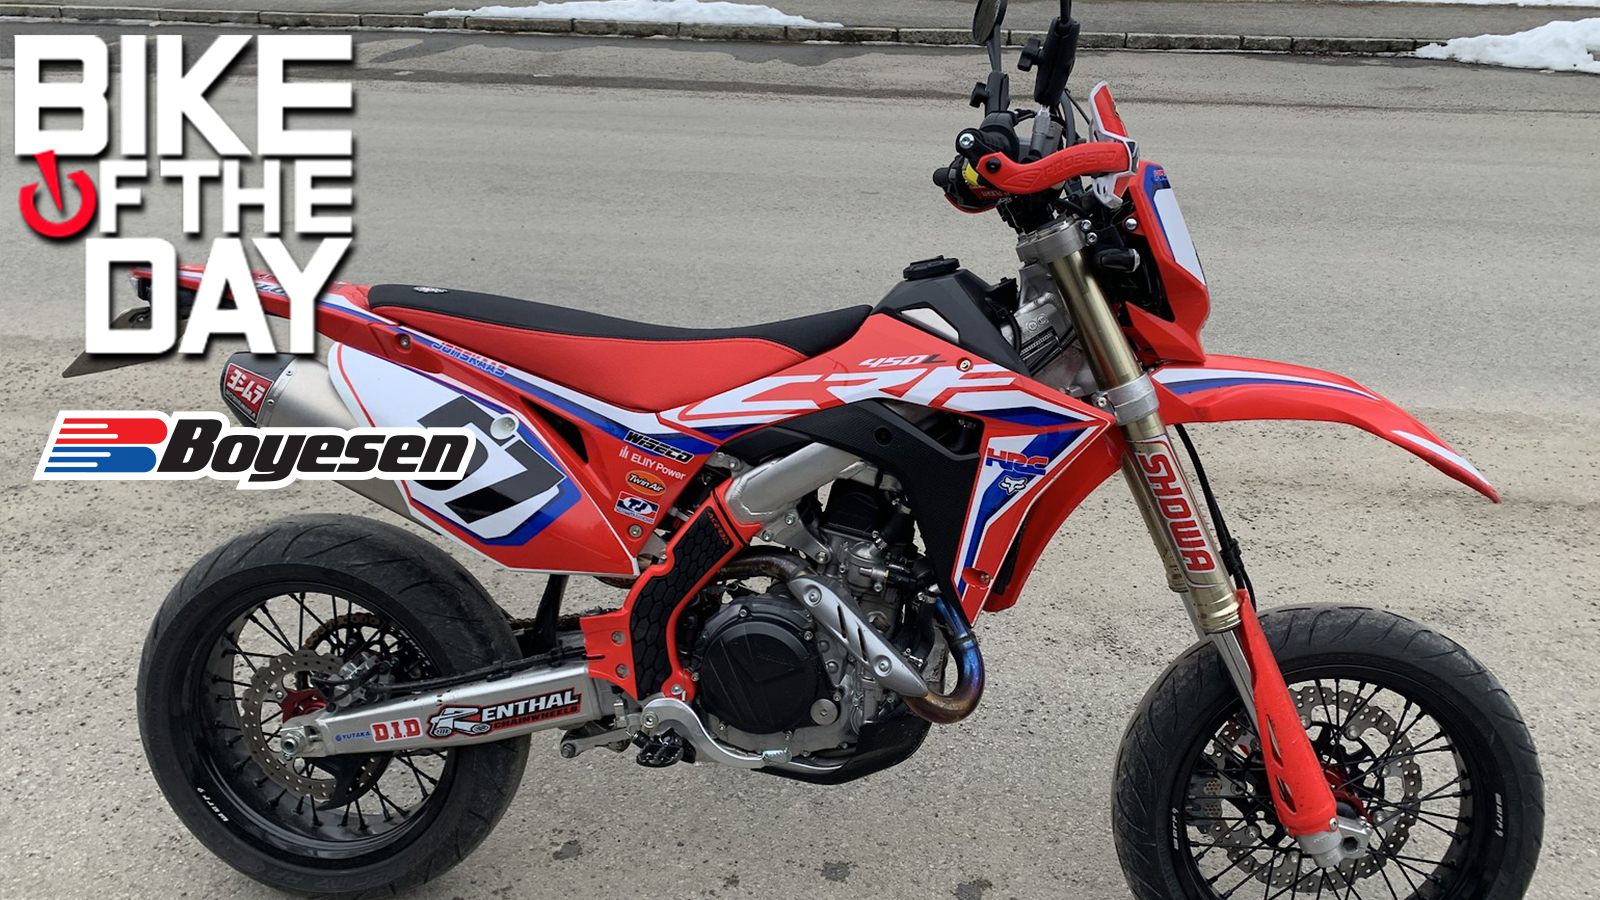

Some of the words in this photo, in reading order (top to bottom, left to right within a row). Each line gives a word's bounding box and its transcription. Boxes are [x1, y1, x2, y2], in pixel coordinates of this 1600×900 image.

[858, 353, 947, 369] 450L
[226, 368, 266, 405] ヨシムラ
[682, 364, 1017, 417] CRF
[655, 462, 686, 480] Power
[985, 447, 1049, 476] HRC
[628, 473, 651, 488] Twin
[648, 482, 665, 493] Air
[1136, 452, 1216, 573] SHOWA
[493, 705, 578, 729] CHAINWHEELS
[342, 731, 372, 740] YUTAKA
